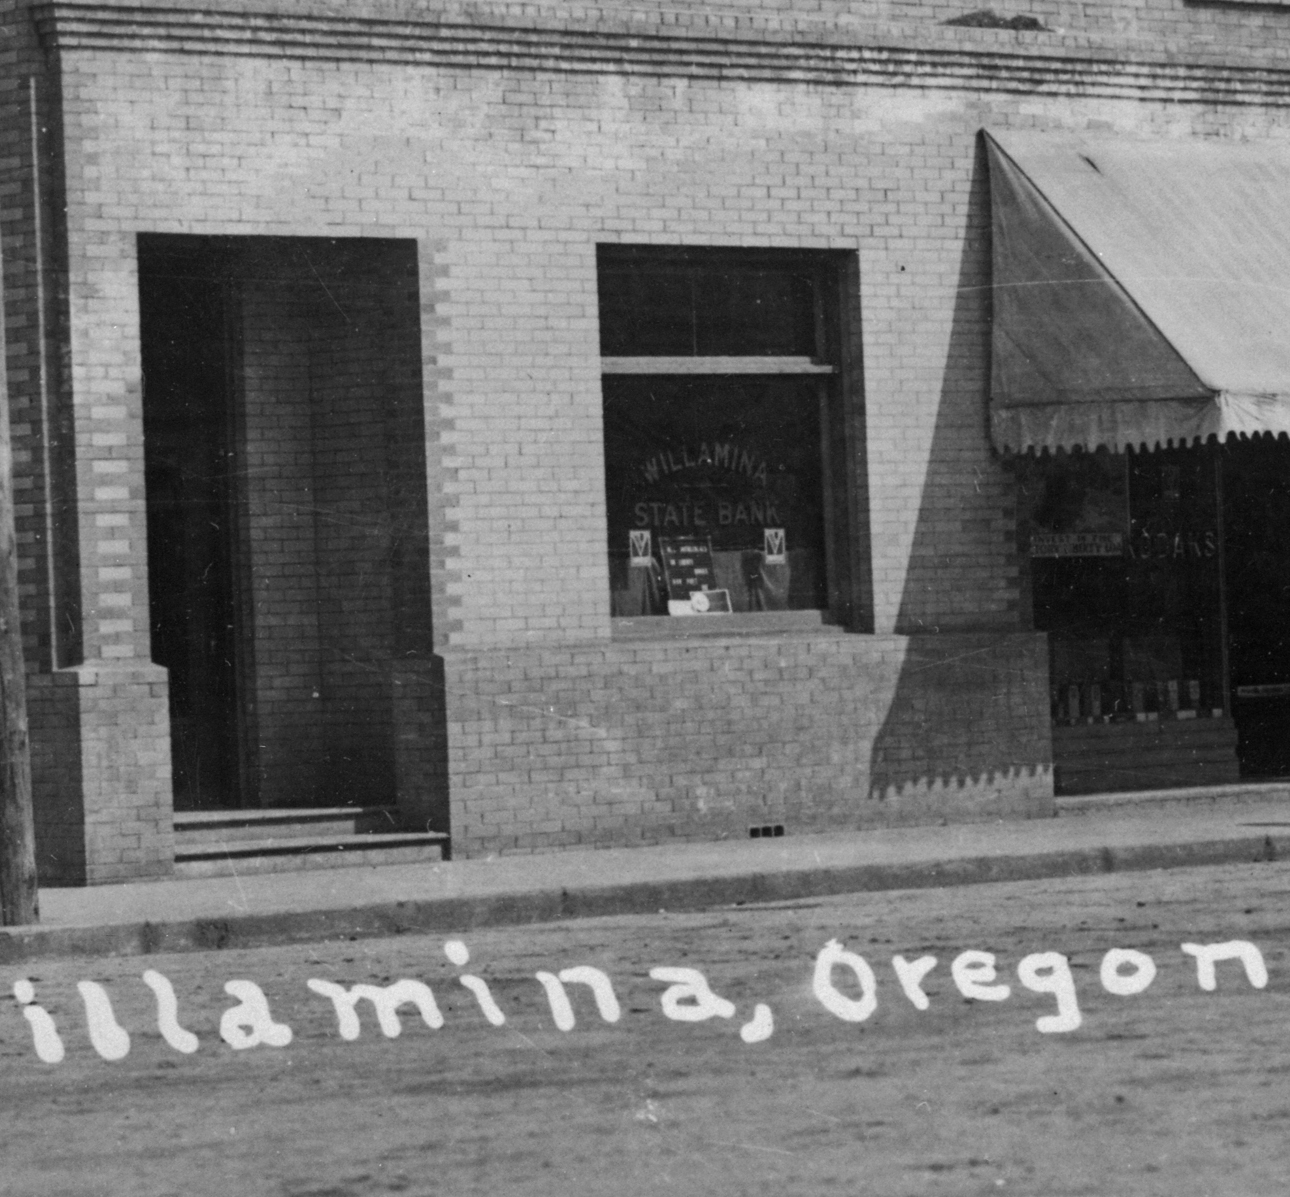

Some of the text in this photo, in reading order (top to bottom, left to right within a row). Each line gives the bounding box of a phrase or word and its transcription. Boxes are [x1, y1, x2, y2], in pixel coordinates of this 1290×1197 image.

[644, 441, 768, 488] WILLAMINA
[634, 500, 781, 526] STATE BANK
